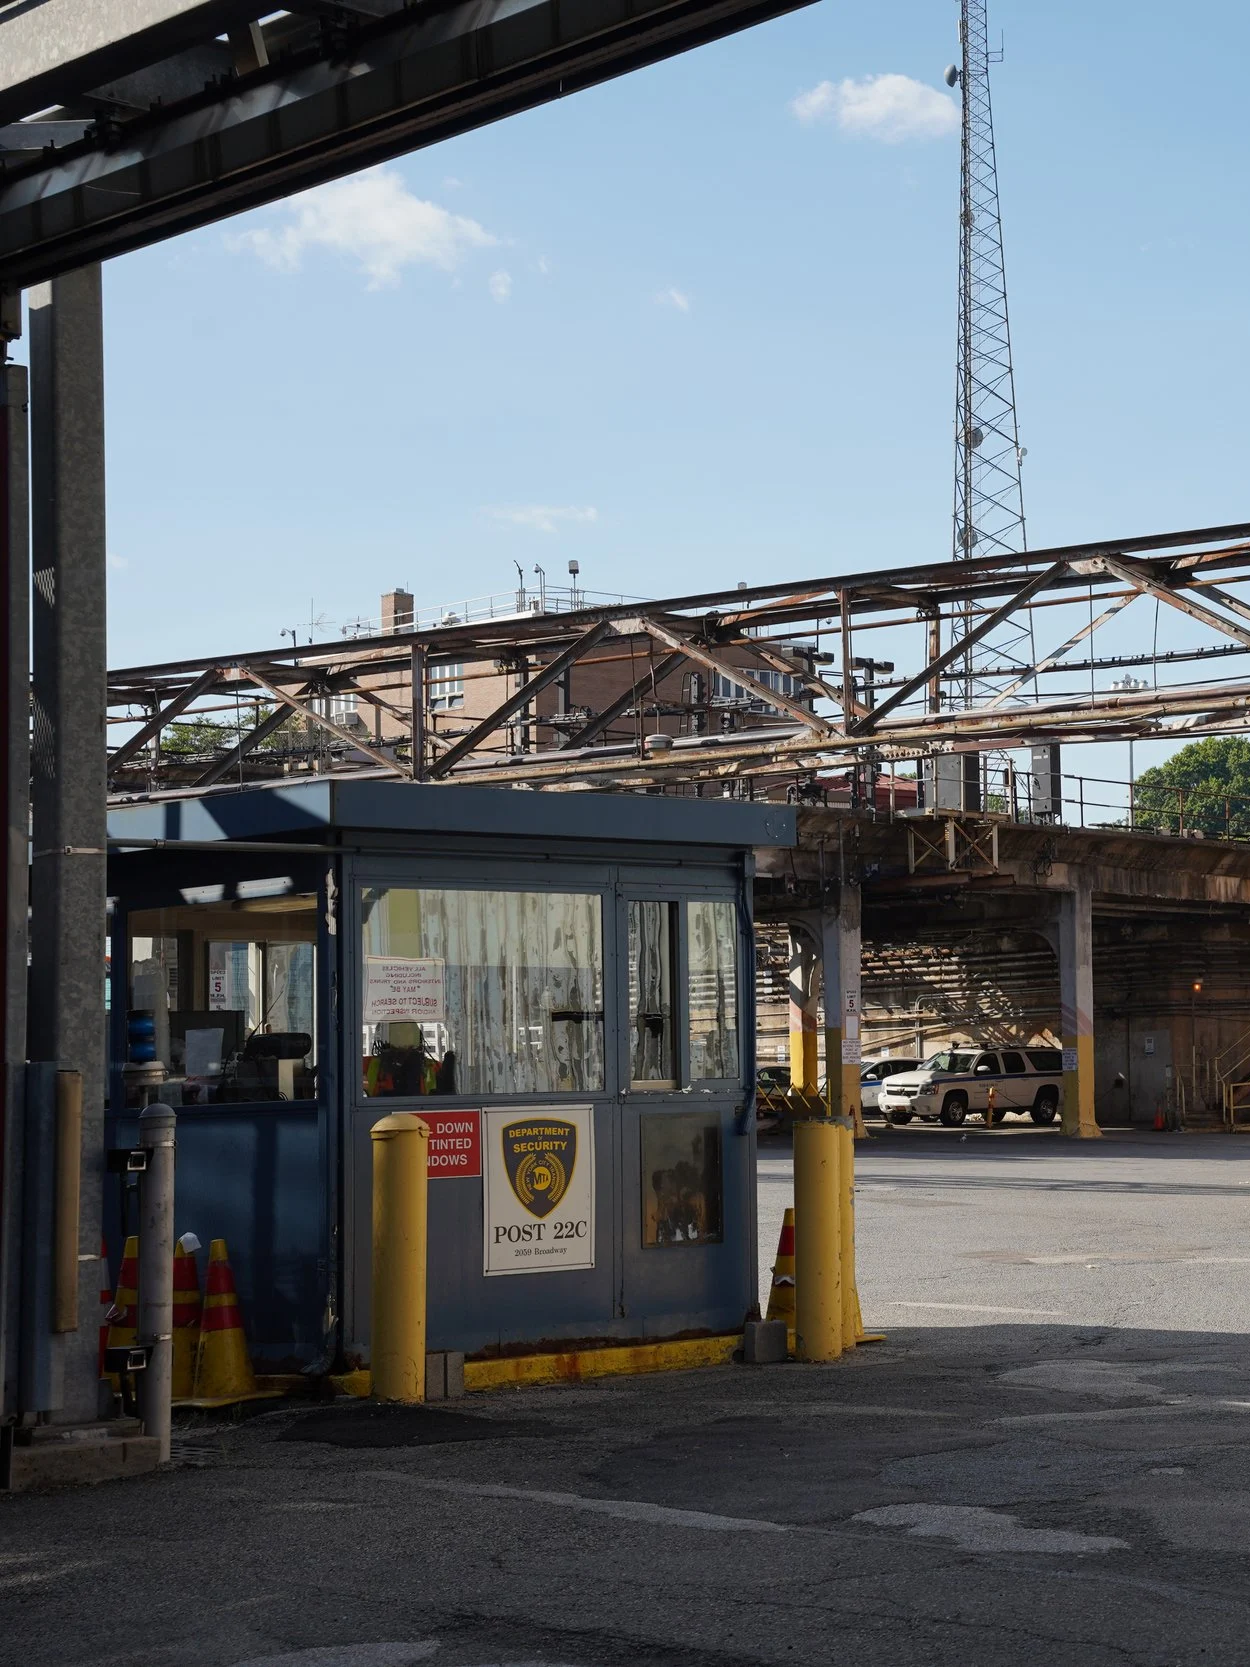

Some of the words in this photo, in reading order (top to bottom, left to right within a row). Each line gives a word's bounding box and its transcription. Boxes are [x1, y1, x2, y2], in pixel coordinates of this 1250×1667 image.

[215, 982, 221, 992] 5
[848, 1000, 854, 1008] 5
[436, 1122, 473, 1134] DOWN
[509, 1128, 570, 1138] DEPARTMENT
[429, 1138, 472, 1150] TINTED
[513, 1141, 568, 1153] SECURITY
[494, 1224, 546, 1243] POST
[553, 1220, 587, 1240] 22C
[514, 1249, 532, 1257] 2059
[534, 1247, 567, 1256] Broadway
